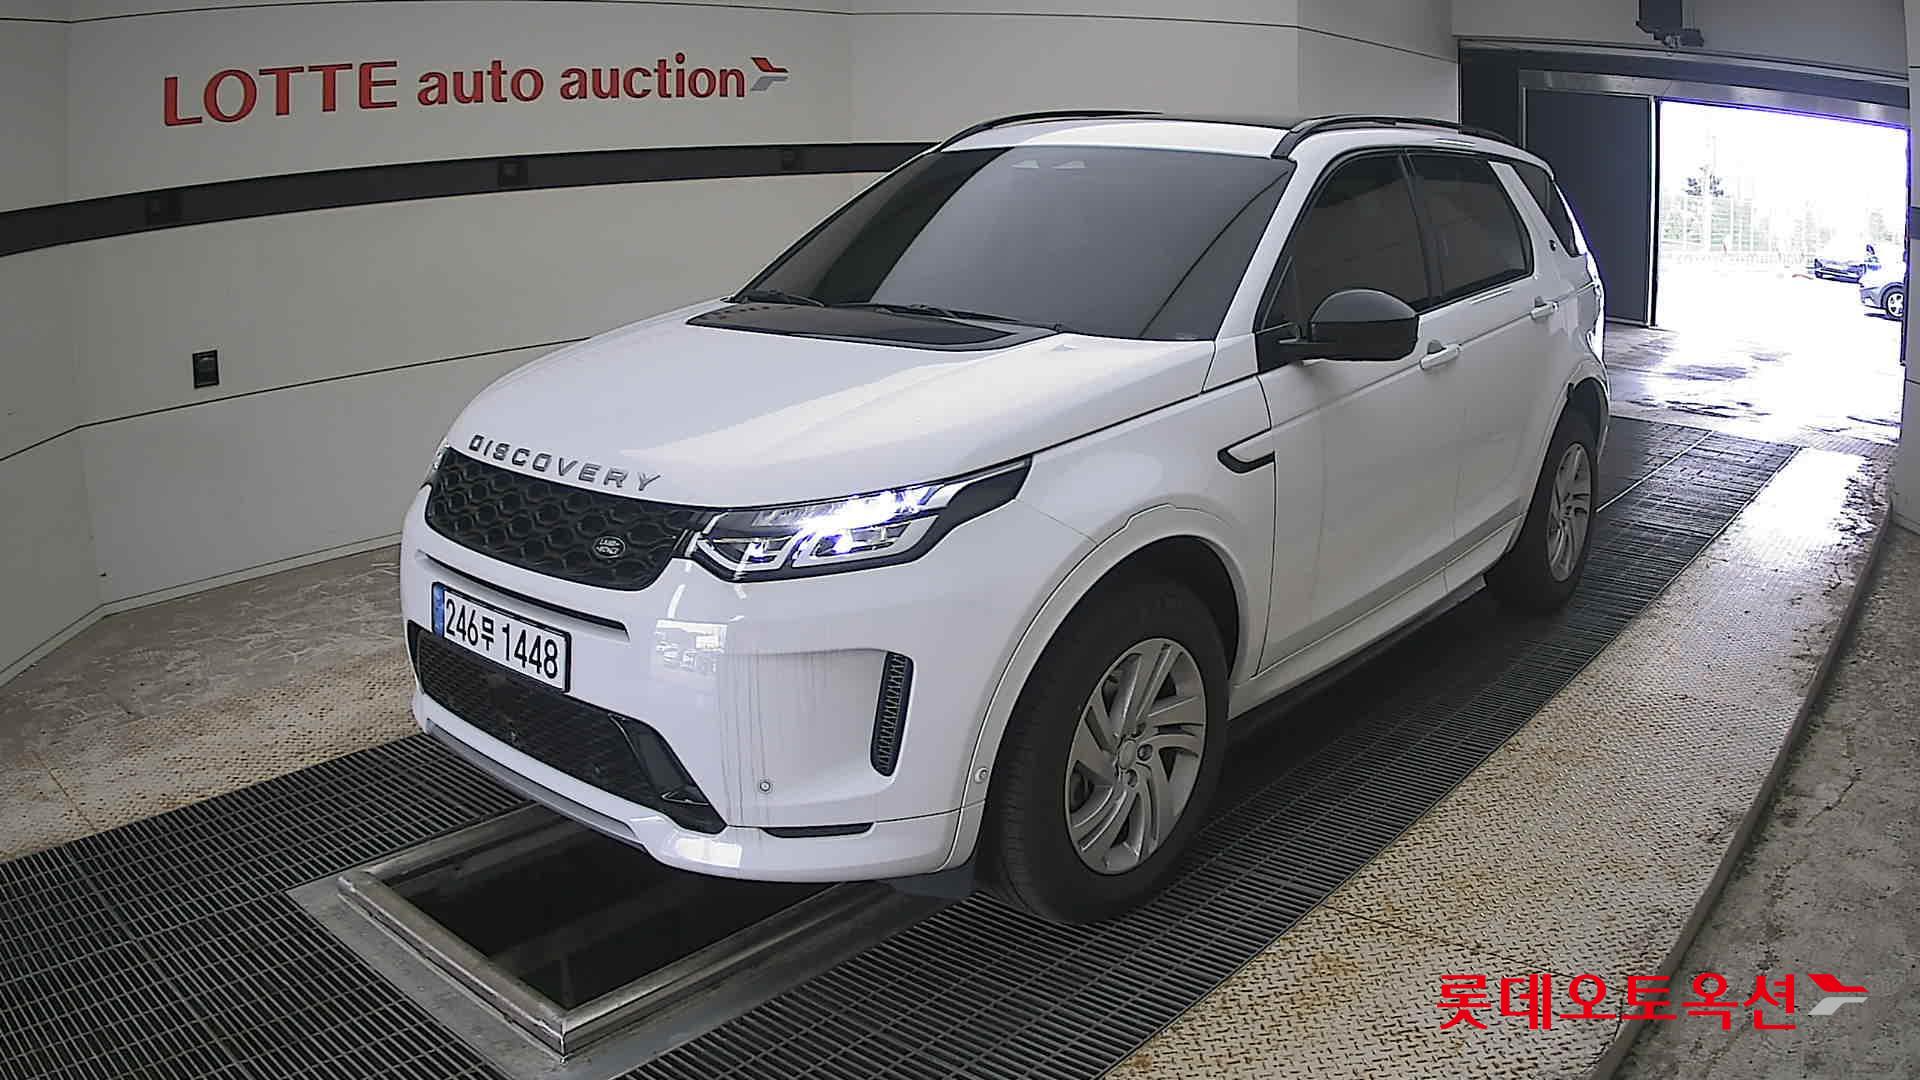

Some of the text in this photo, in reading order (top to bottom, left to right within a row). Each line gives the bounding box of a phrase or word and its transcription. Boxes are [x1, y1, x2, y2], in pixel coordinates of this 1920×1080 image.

[163, 52, 745, 126] LOTTE auto auction
[469, 435, 661, 491] DISCOVERY
[446, 598, 557, 679] 246무 1448
